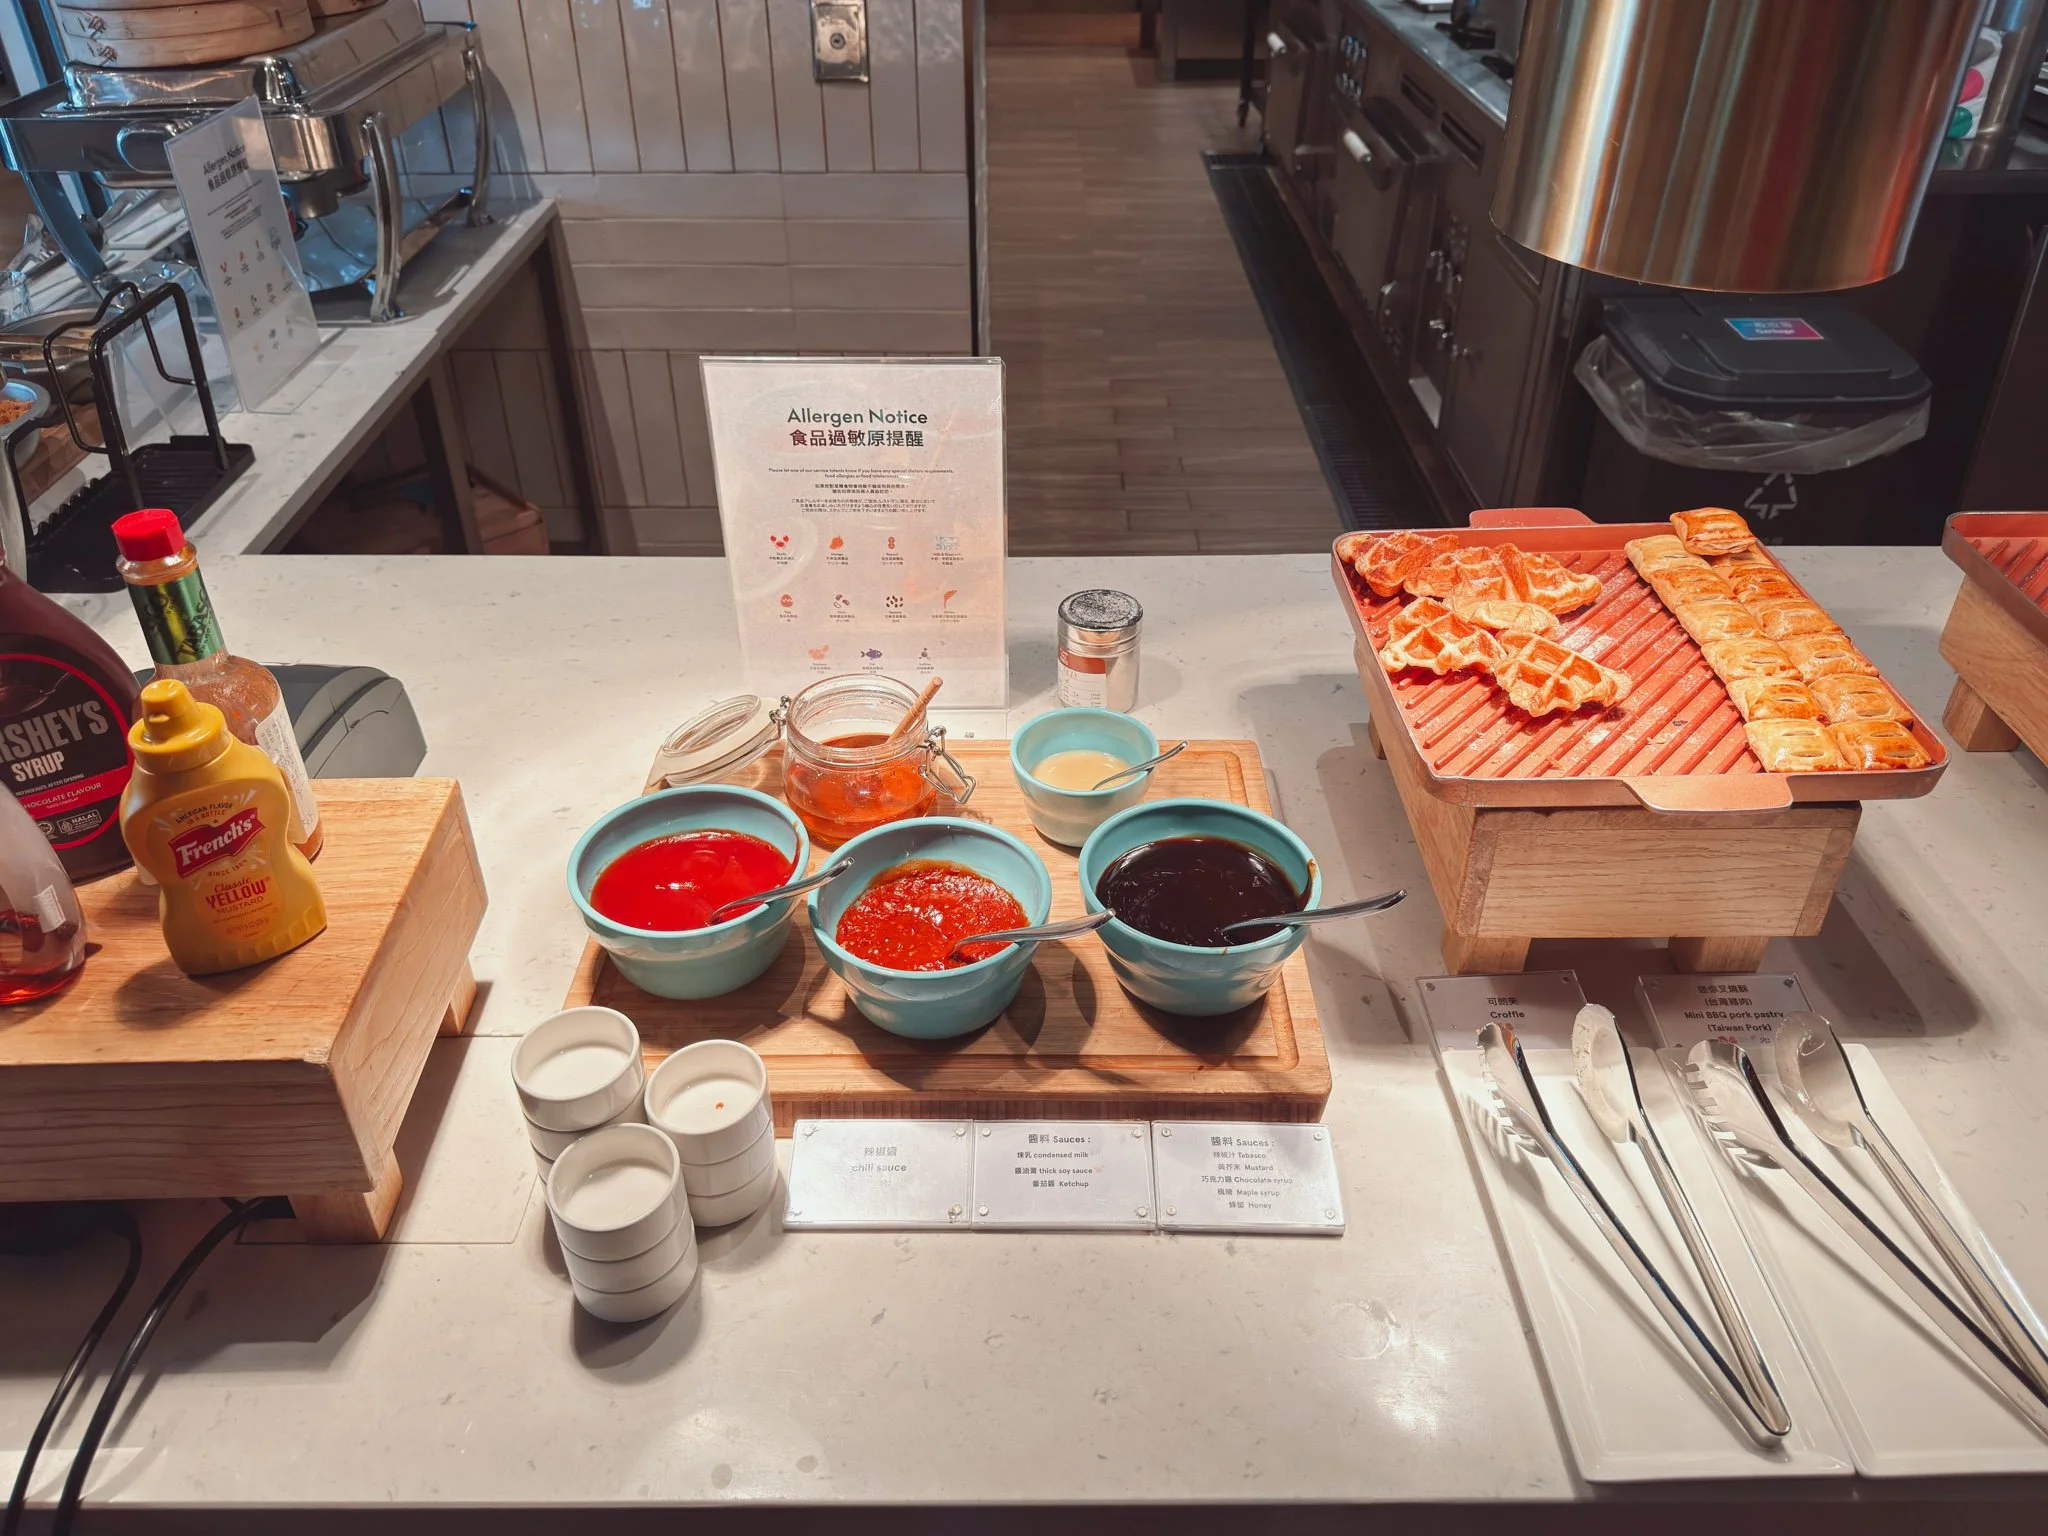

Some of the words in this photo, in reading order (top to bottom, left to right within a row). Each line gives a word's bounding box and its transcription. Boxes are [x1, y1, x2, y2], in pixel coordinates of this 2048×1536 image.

[787, 408, 864, 428] Allergen
[869, 408, 928, 424] Notice
[789, 429, 924, 447] 食品過敏原提醒
[11, 751, 65, 782] SYRUP
[24, 794, 66, 809] HOCOLATE
[67, 782, 101, 798] FLAVOUR
[71, 812, 98, 824] HALAL
[176, 818, 253, 867] French's
[214, 877, 251, 893] Classic
[205, 879, 267, 910] YELLOW
[217, 895, 264, 914] MUSTARD
[1684, 1011, 1705, 1019] Mini
[1706, 1011, 1727, 1019] BBQ
[1729, 1011, 1752, 1019] pork
[1708, 1024, 1744, 1032] (Taiwan
[1745, 1024, 1772, 1032] Pork)
[1053, 1135, 1086, 1143] Sauces
[1236, 1138, 1269, 1147] Sauces
[851, 1163, 873, 1172] chili
[876, 1164, 907, 1172] sauce
[1059, 1180, 1089, 1188] Ketchup
[1273, 1177, 1293, 1185] syrup
[1236, 1189, 1259, 1197] Maple
[1248, 1202, 1272, 1210] Honey
